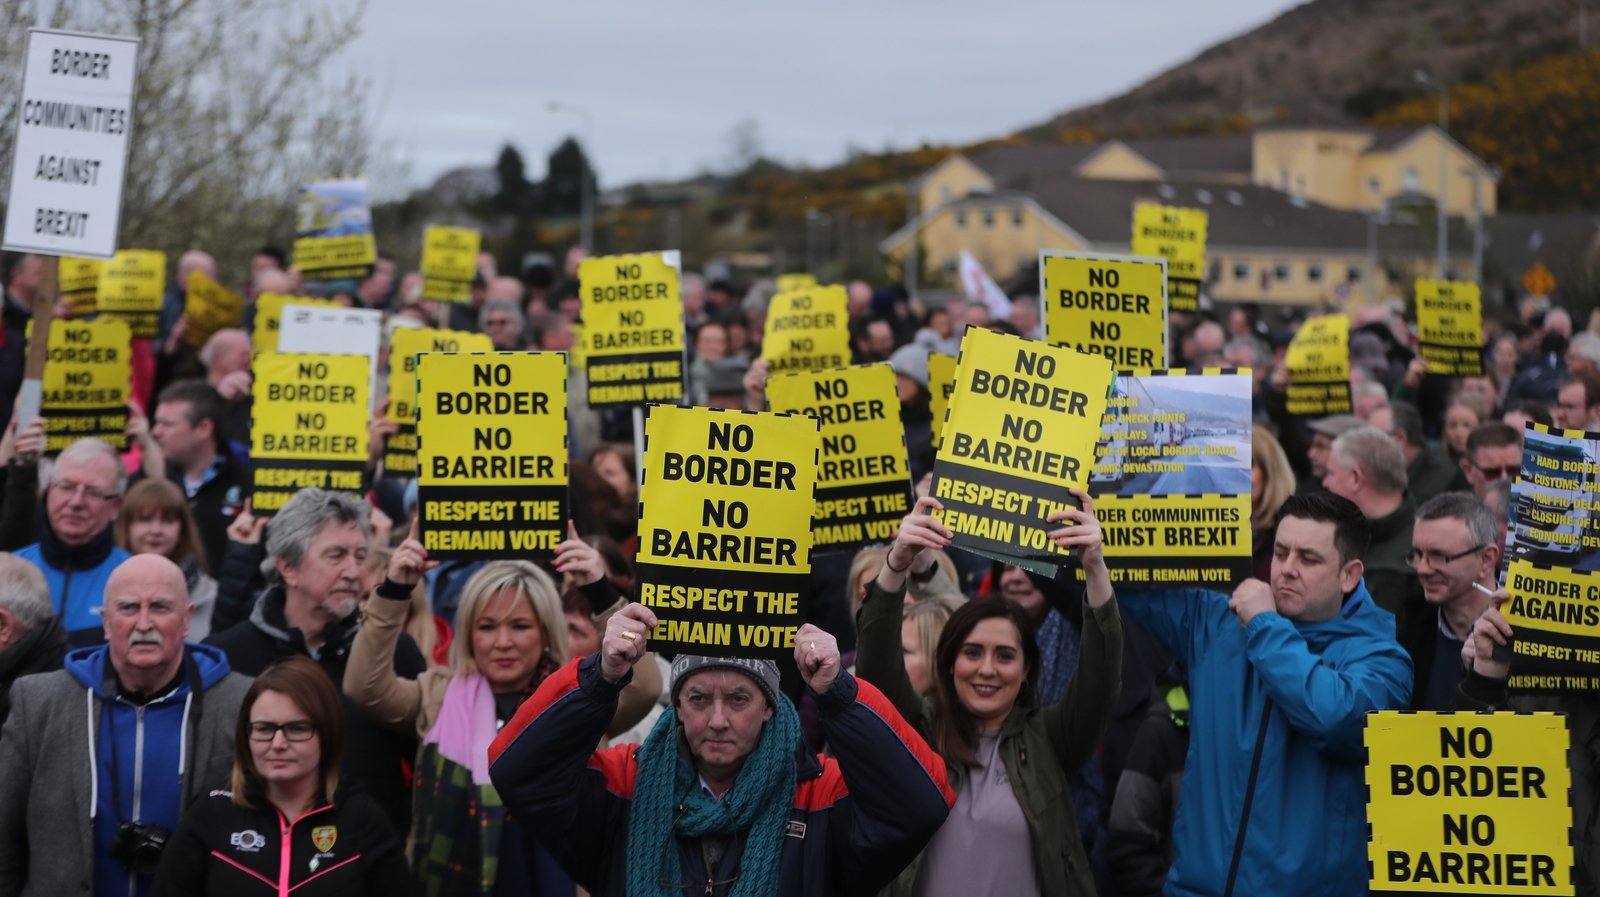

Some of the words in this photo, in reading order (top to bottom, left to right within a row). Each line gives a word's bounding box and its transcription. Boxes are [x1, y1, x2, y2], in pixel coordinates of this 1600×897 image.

[50, 48, 111, 80] BORDER
[23, 99, 127, 135] COMMUNITIES
[34, 155, 103, 186] AGAINST
[34, 208, 90, 238] BREXIT
[616, 264, 641, 280] NO
[1089, 268, 1120, 288] NO
[592, 283, 668, 303] BORDER
[1060, 290, 1150, 315] BORDER
[620, 310, 645, 327] NO
[64, 329, 92, 345] NO
[593, 329, 674, 350] BARRIER
[1090, 321, 1121, 341] NO
[47, 347, 119, 363] ORDER
[791, 338, 814, 352] NO
[298, 363, 327, 379] NO
[589, 362, 650, 382] RESPECT
[651, 360, 681, 379] THE
[1015, 349, 1056, 379] NO
[65, 372, 93, 387] NO
[474, 364, 511, 387] NO
[268, 384, 356, 402] BORDER
[814, 379, 848, 400] NO
[970, 368, 1089, 417] BORDER
[436, 392, 549, 415] BORDER
[785, 400, 885, 425] RDER
[296, 413, 325, 430] NO
[1001, 414, 1043, 443] NO
[263, 434, 357, 453] BARRIER
[474, 428, 512, 450] NO
[708, 422, 754, 452] NO
[822, 435, 856, 456] NO
[952, 432, 1081, 482] BARRIER
[1131, 446, 1160, 456] LOCAL
[1163, 446, 1201, 456] BORDER
[432, 456, 554, 479] BARRIER
[663, 452, 796, 490] BORDER
[817, 455, 897, 482] RRIER
[1123, 463, 1185, 473] DEVASTATION
[1537, 455, 1559, 470] HARD
[1562, 461, 1600, 475] BORDE
[254, 468, 326, 487] RESPECT
[330, 470, 362, 489] THE
[1534, 474, 1580, 490] CUSTOMS
[815, 498, 868, 520] SPECT
[871, 493, 907, 513] THE
[936, 477, 1033, 515] RESPECT
[1533, 492, 1570, 508] TRAFFIC
[1573, 500, 1600, 512] DELA
[425, 501, 516, 521] RESPECT
[520, 501, 560, 521] THE
[702, 499, 749, 529] NO
[1131, 507, 1240, 523] COMMUNITIES
[1531, 508, 1573, 526] CLOSURE
[1577, 518, 1591, 528] OF
[424, 530, 505, 550] REMAIN
[509, 530, 561, 550] VOTE
[865, 520, 901, 540] VOT
[1101, 527, 1157, 547] AINST
[1164, 527, 1240, 547] BREXIT
[1529, 527, 1579, 545] ECONOMIC
[651, 528, 797, 566] BARRIER
[1127, 568, 1150, 581] THE
[1152, 568, 1199, 581] REMAIN
[1201, 568, 1231, 581] VOTE
[1513, 574, 1581, 600] BORDER
[641, 583, 749, 613] RESPECT
[753, 591, 799, 615] THE
[1509, 595, 1600, 627] AGAINS
[738, 624, 797, 648] VOTE
[1513, 640, 1572, 660] RESPECT
[1575, 649, 1600, 664] THE
[1564, 677, 1588, 689] THE
[1440, 727, 1492, 759] NO
[1391, 764, 1547, 798] BORDER
[1443, 814, 1495, 846] NO
[1387, 850, 1556, 887] BARRIER
